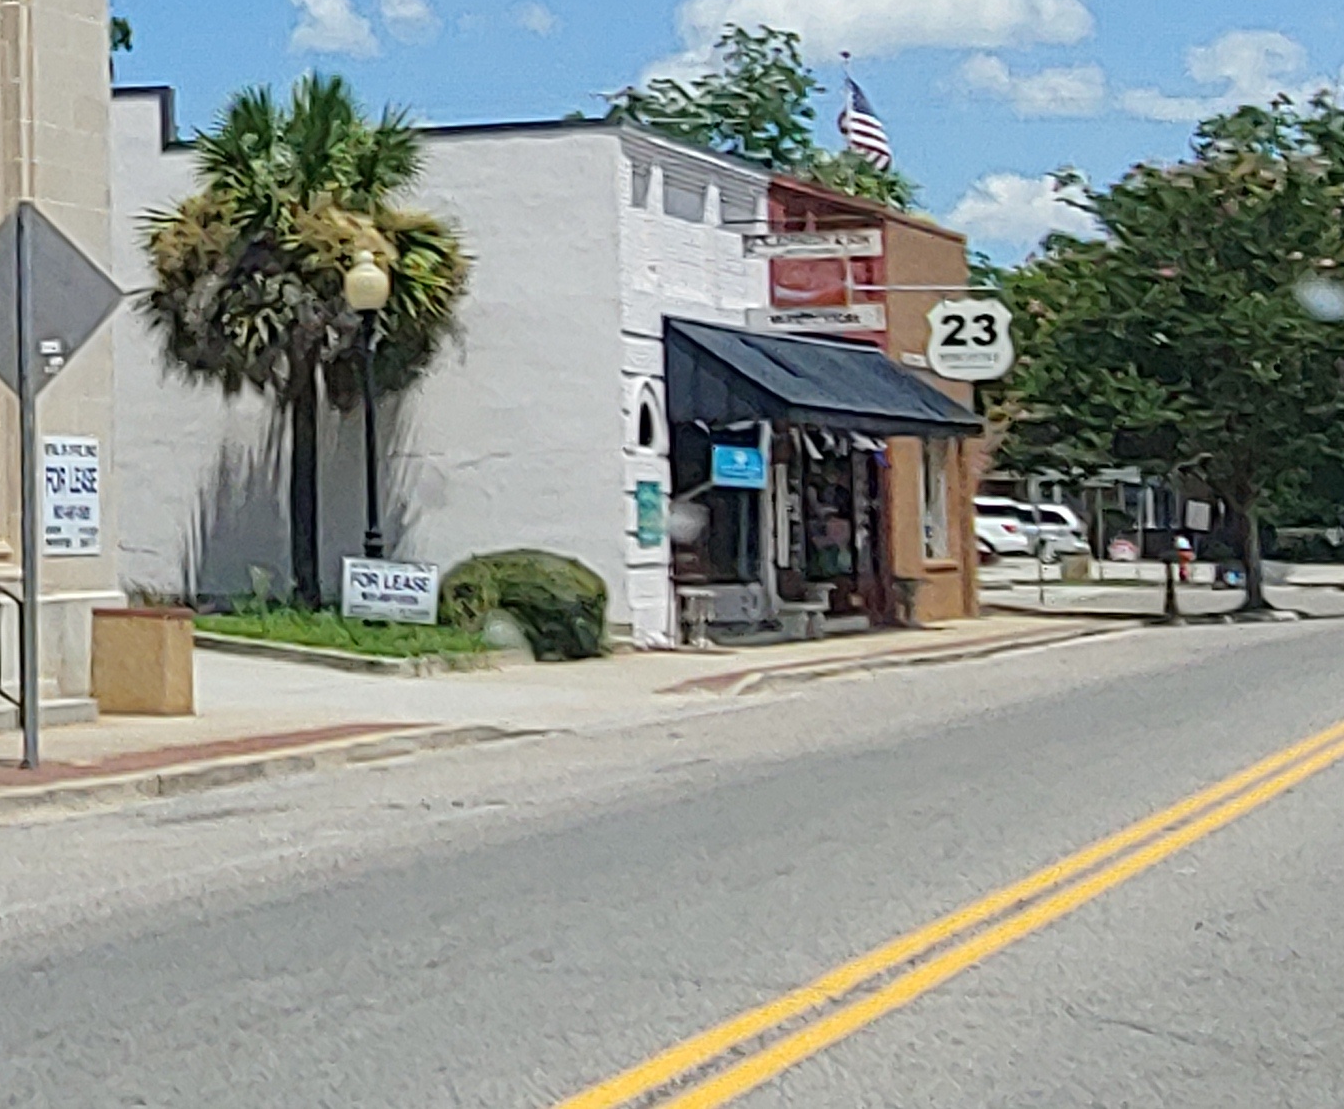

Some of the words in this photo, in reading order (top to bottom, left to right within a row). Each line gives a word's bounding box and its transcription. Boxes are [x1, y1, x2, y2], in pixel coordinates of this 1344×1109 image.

[940, 314, 998, 346] 23
[46, 466, 66, 494] FOR
[70, 466, 97, 493] LEASE
[351, 572, 379, 589] FOR
[384, 574, 430, 593] LEASE
